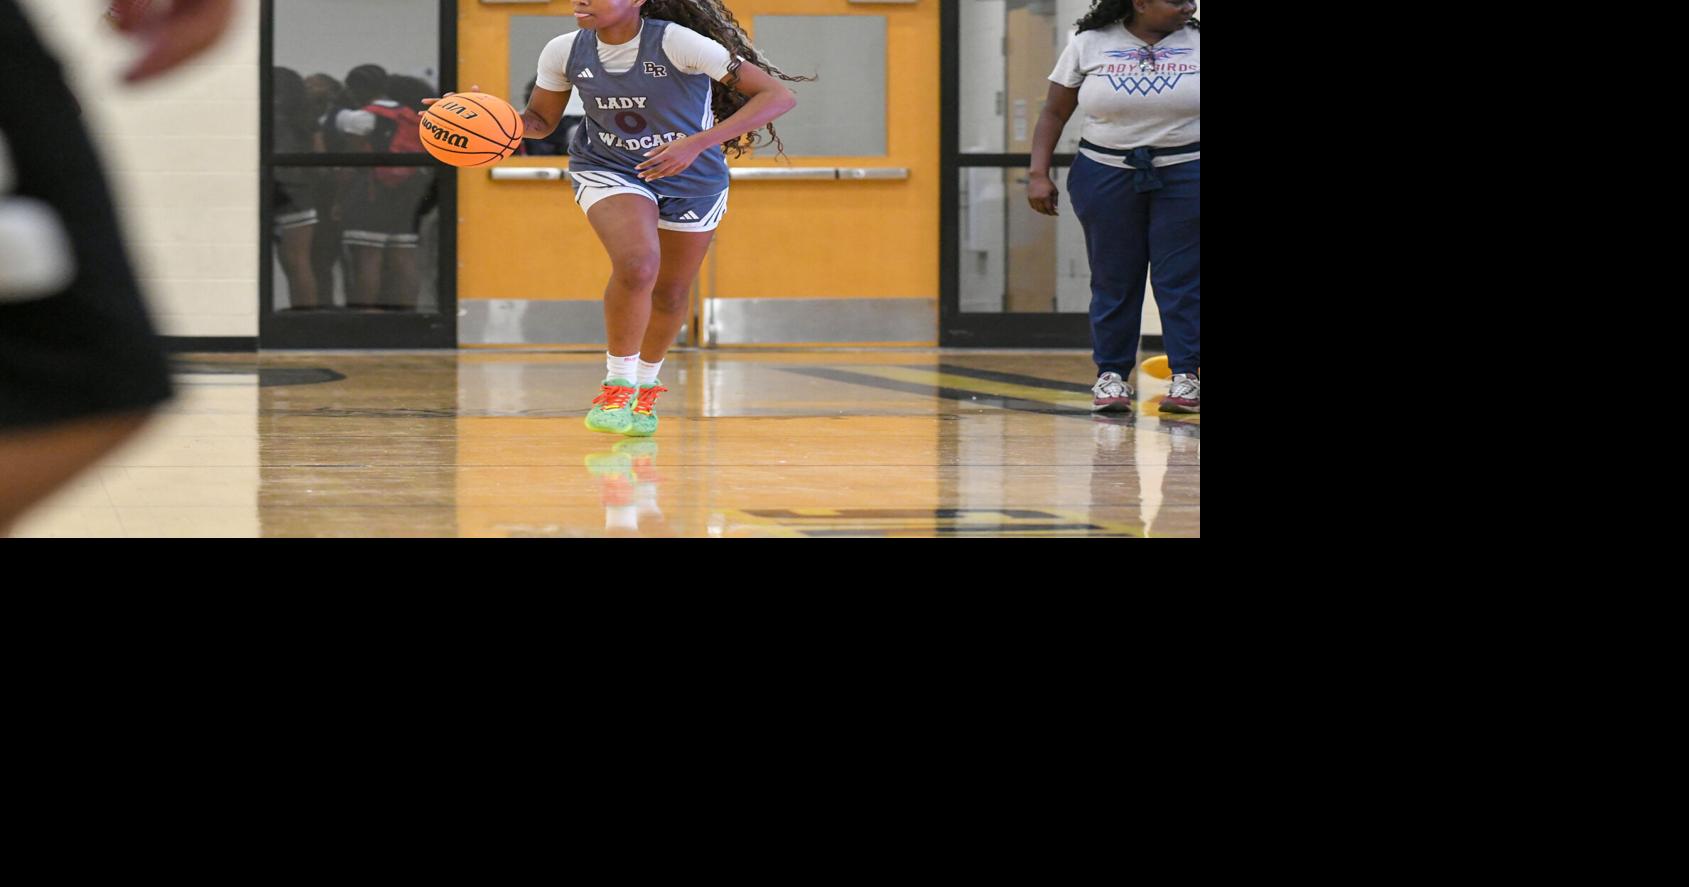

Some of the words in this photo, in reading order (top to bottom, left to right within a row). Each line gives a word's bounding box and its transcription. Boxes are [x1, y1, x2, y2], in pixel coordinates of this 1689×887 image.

[643, 62, 667, 77] BR
[1099, 64, 1136, 73] ADY
[595, 97, 646, 109] LADY
[615, 111, 647, 134] 0
[421, 117, 469, 149] Wilson
